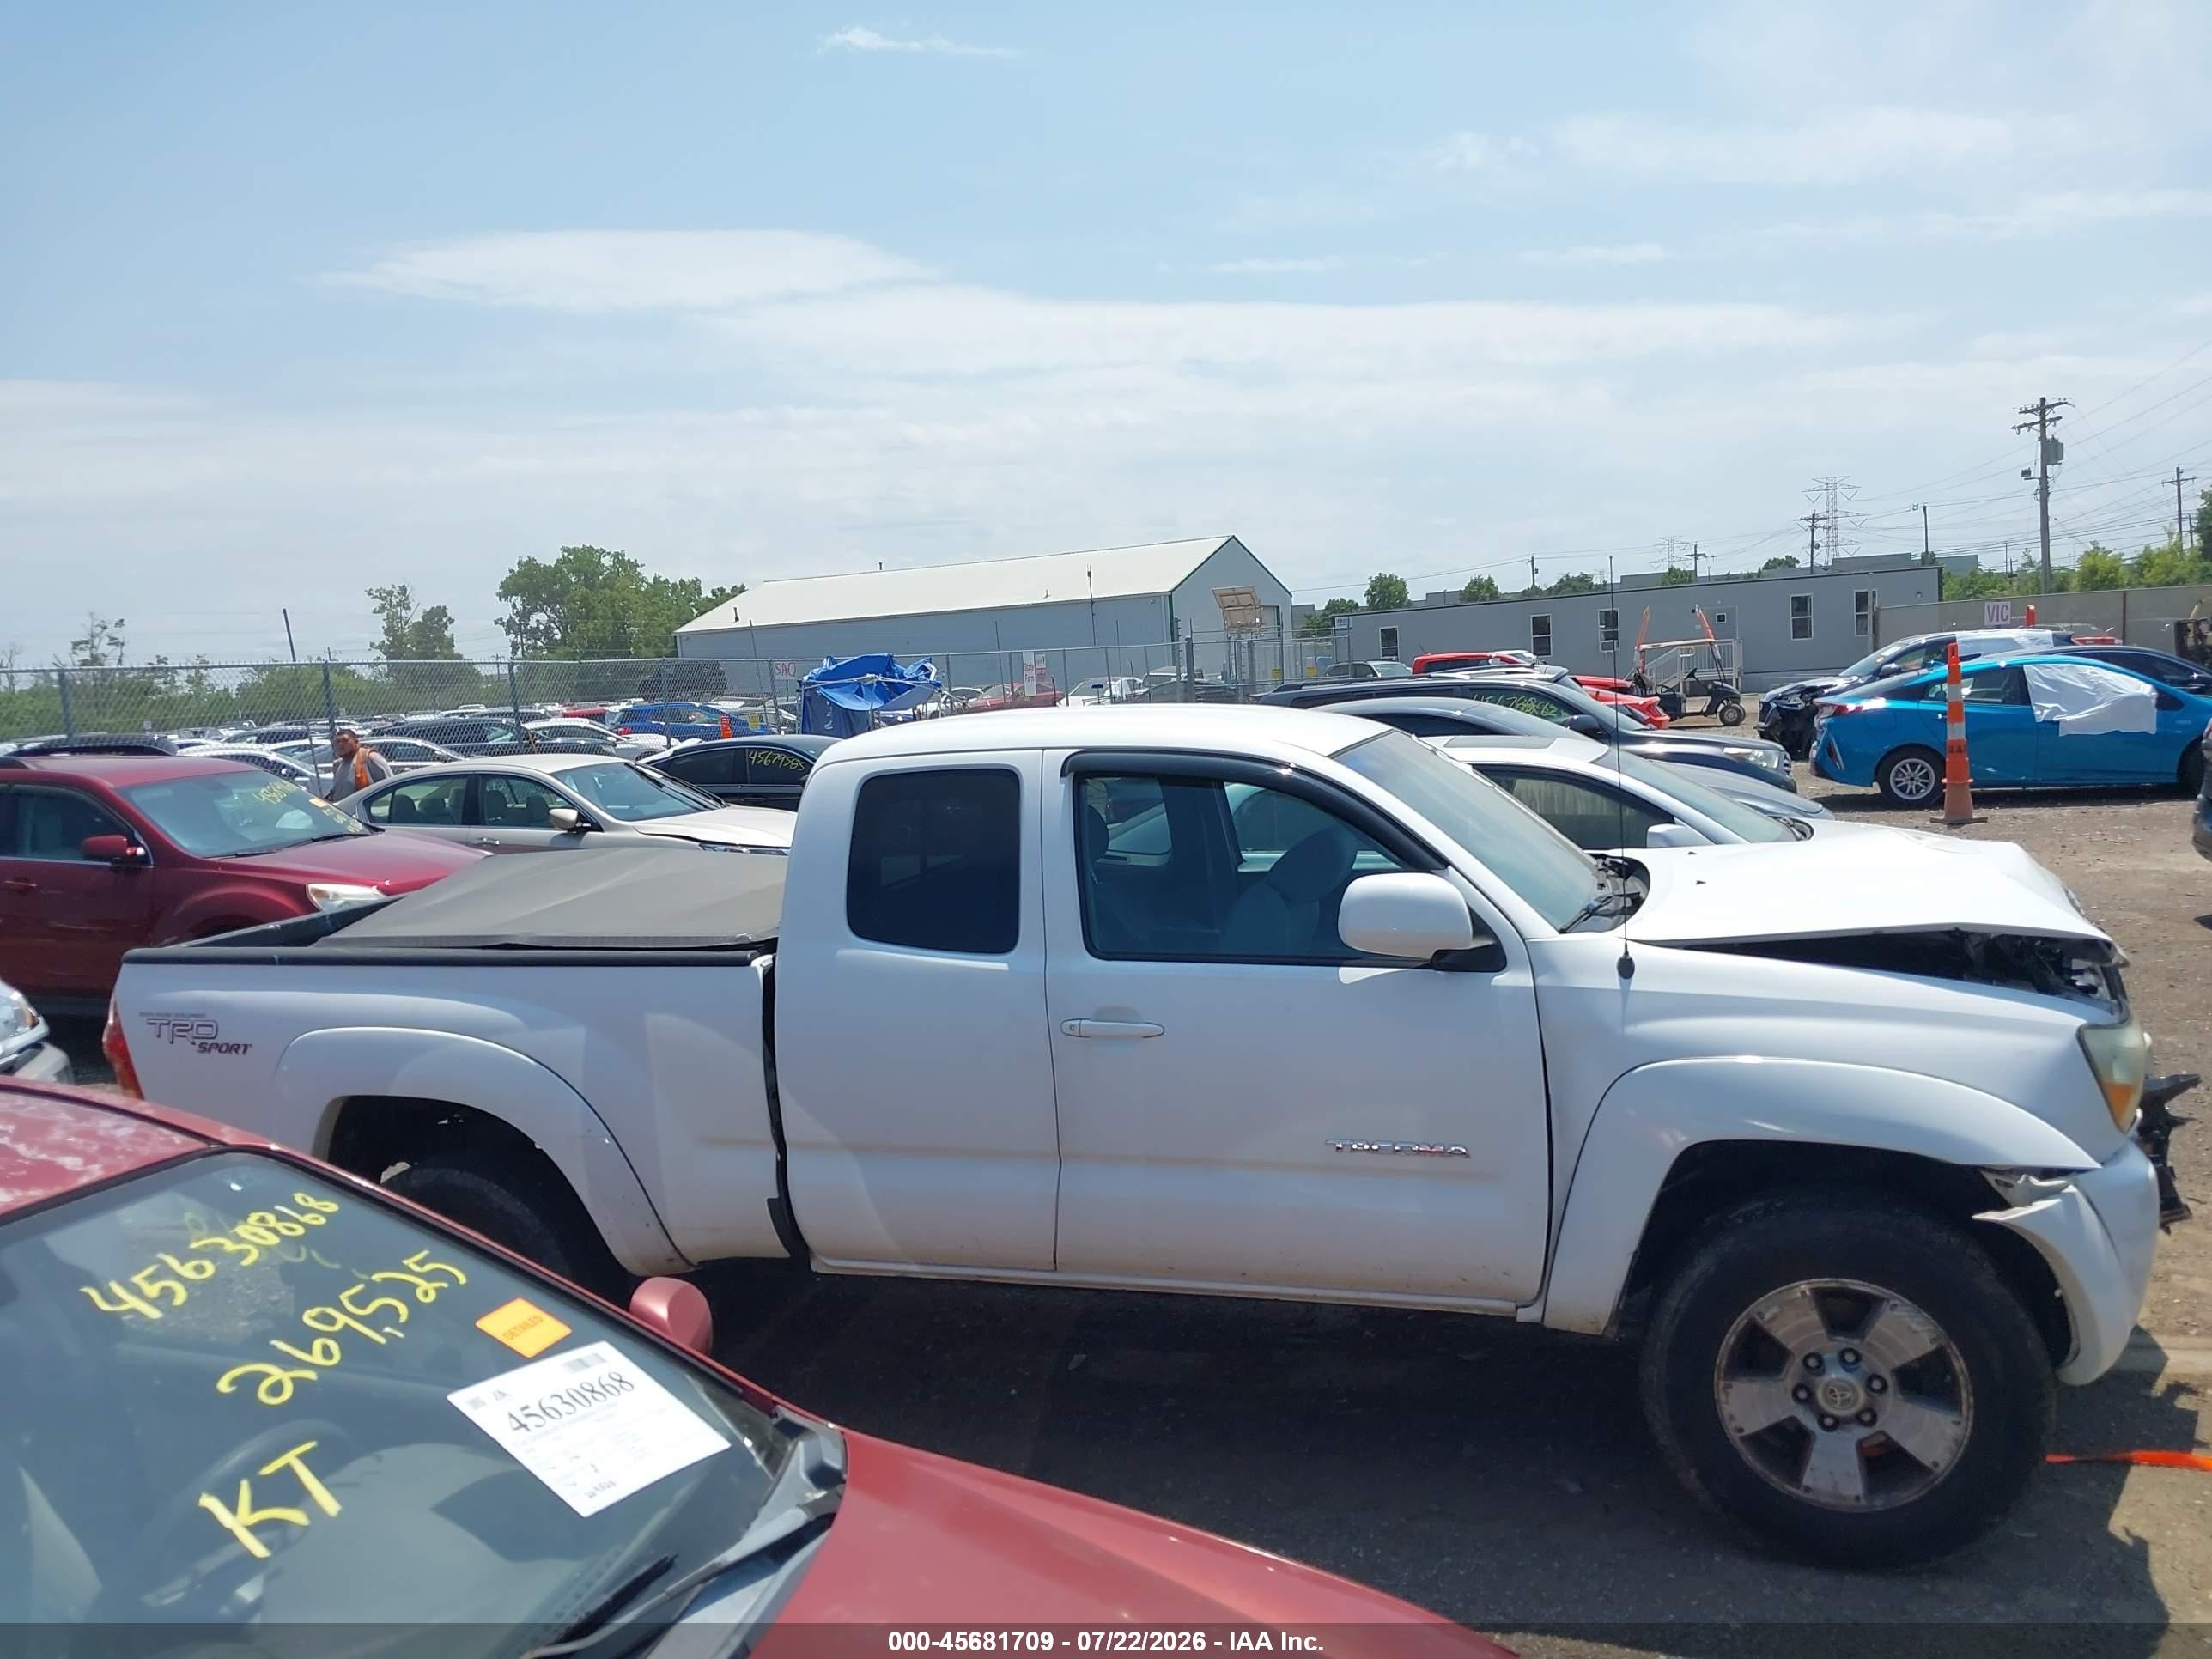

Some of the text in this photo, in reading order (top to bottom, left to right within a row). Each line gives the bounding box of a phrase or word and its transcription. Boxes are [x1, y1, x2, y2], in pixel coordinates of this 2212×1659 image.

[1986, 604, 2009, 622] VIC
[147, 1018, 219, 1044] TRD
[197, 1042, 251, 1056] SPORT
[79, 1191, 340, 1320] 45630868
[507, 1371, 635, 1433] 45630868
[198, 1440, 342, 1559] KT
